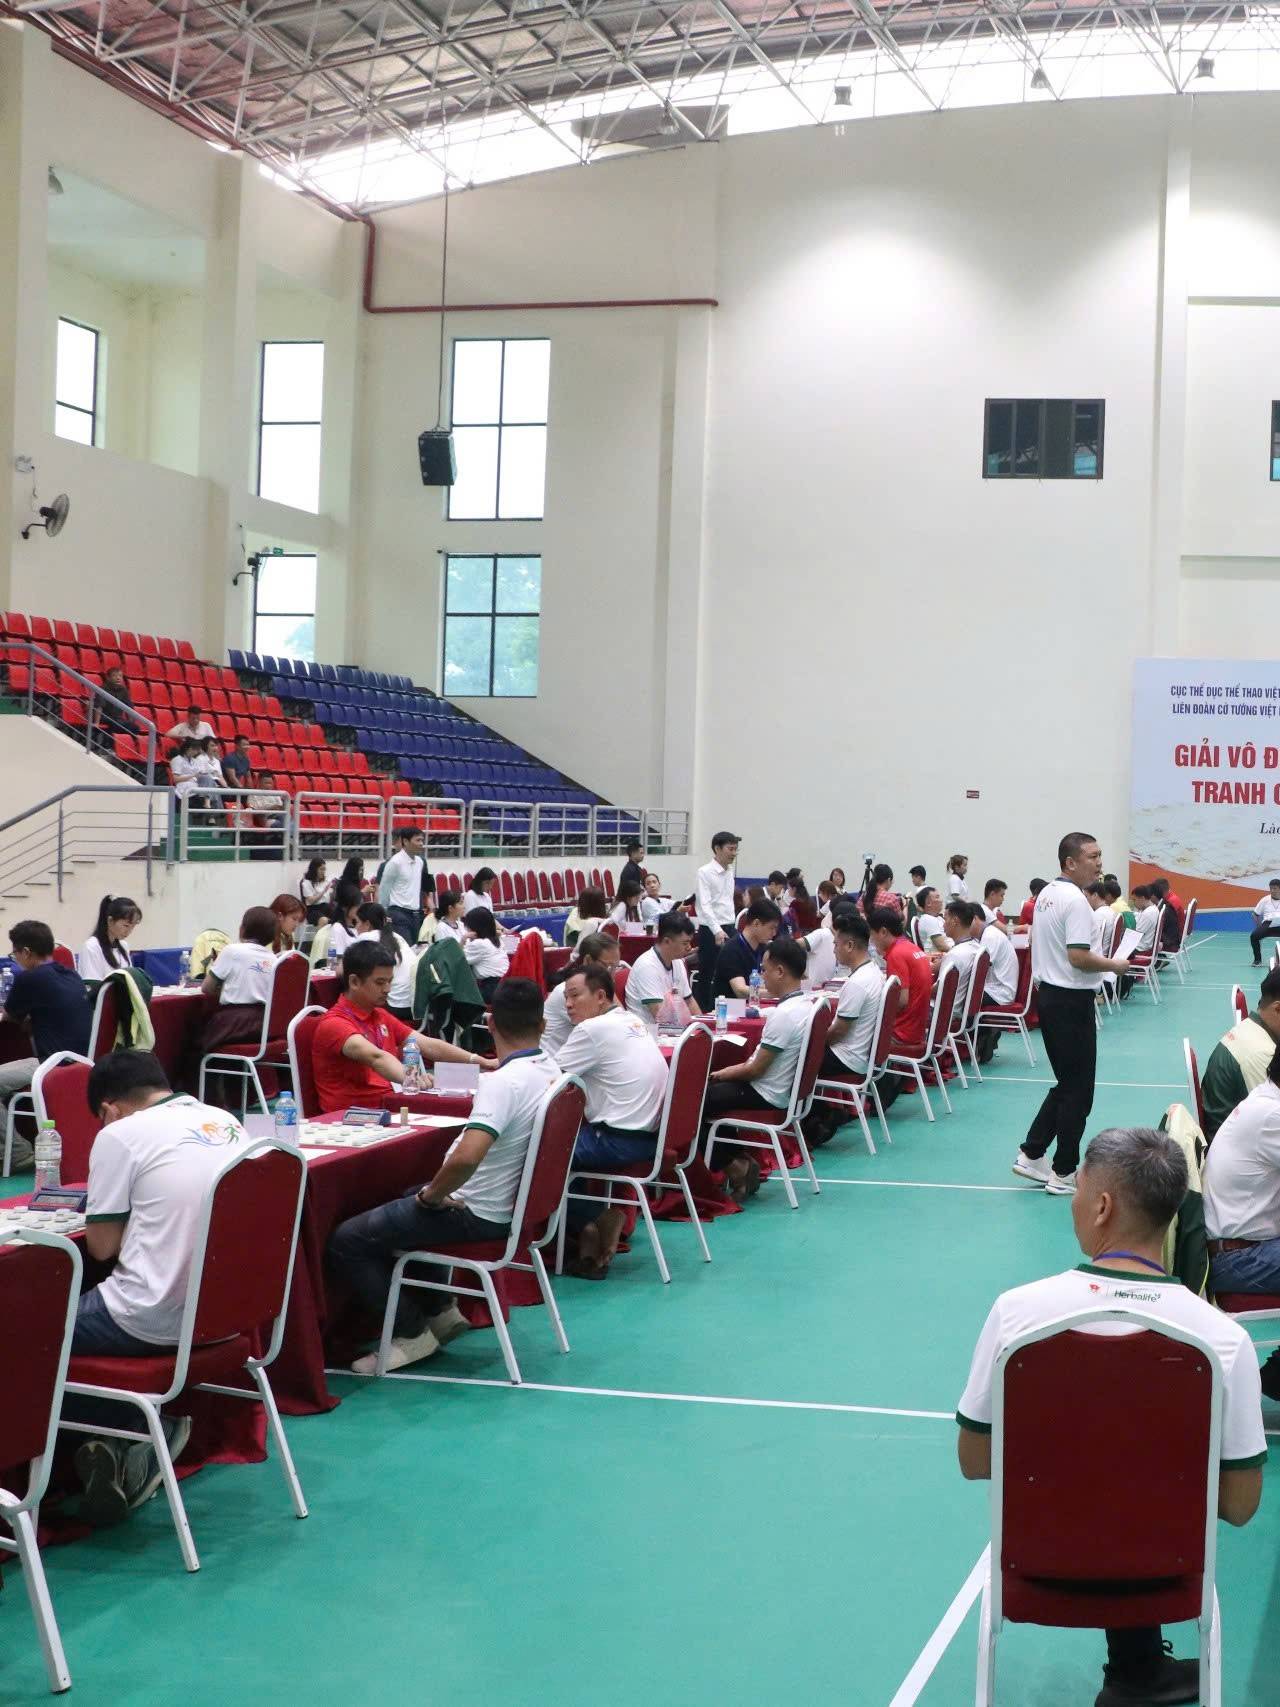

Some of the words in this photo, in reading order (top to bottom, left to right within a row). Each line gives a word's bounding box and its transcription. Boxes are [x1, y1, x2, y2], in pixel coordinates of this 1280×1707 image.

[1171, 685, 1187, 699] CỤC
[1206, 686, 1223, 700] DỤC
[1242, 687, 1262, 699] THAO
[1172, 702, 1190, 714] LIÊN
[1192, 702, 1215, 715] ĐOÀN
[1217, 703, 1229, 715] CỜ
[1231, 703, 1258, 716] TƯỚNG
[1260, 703, 1276, 718] VIỆT
[1174, 737, 1220, 768] GIẢI
[1227, 741, 1257, 769] VÔ
[1191, 780, 1266, 805] TRANH
[1114, 1290, 1157, 1303] Herbalife
